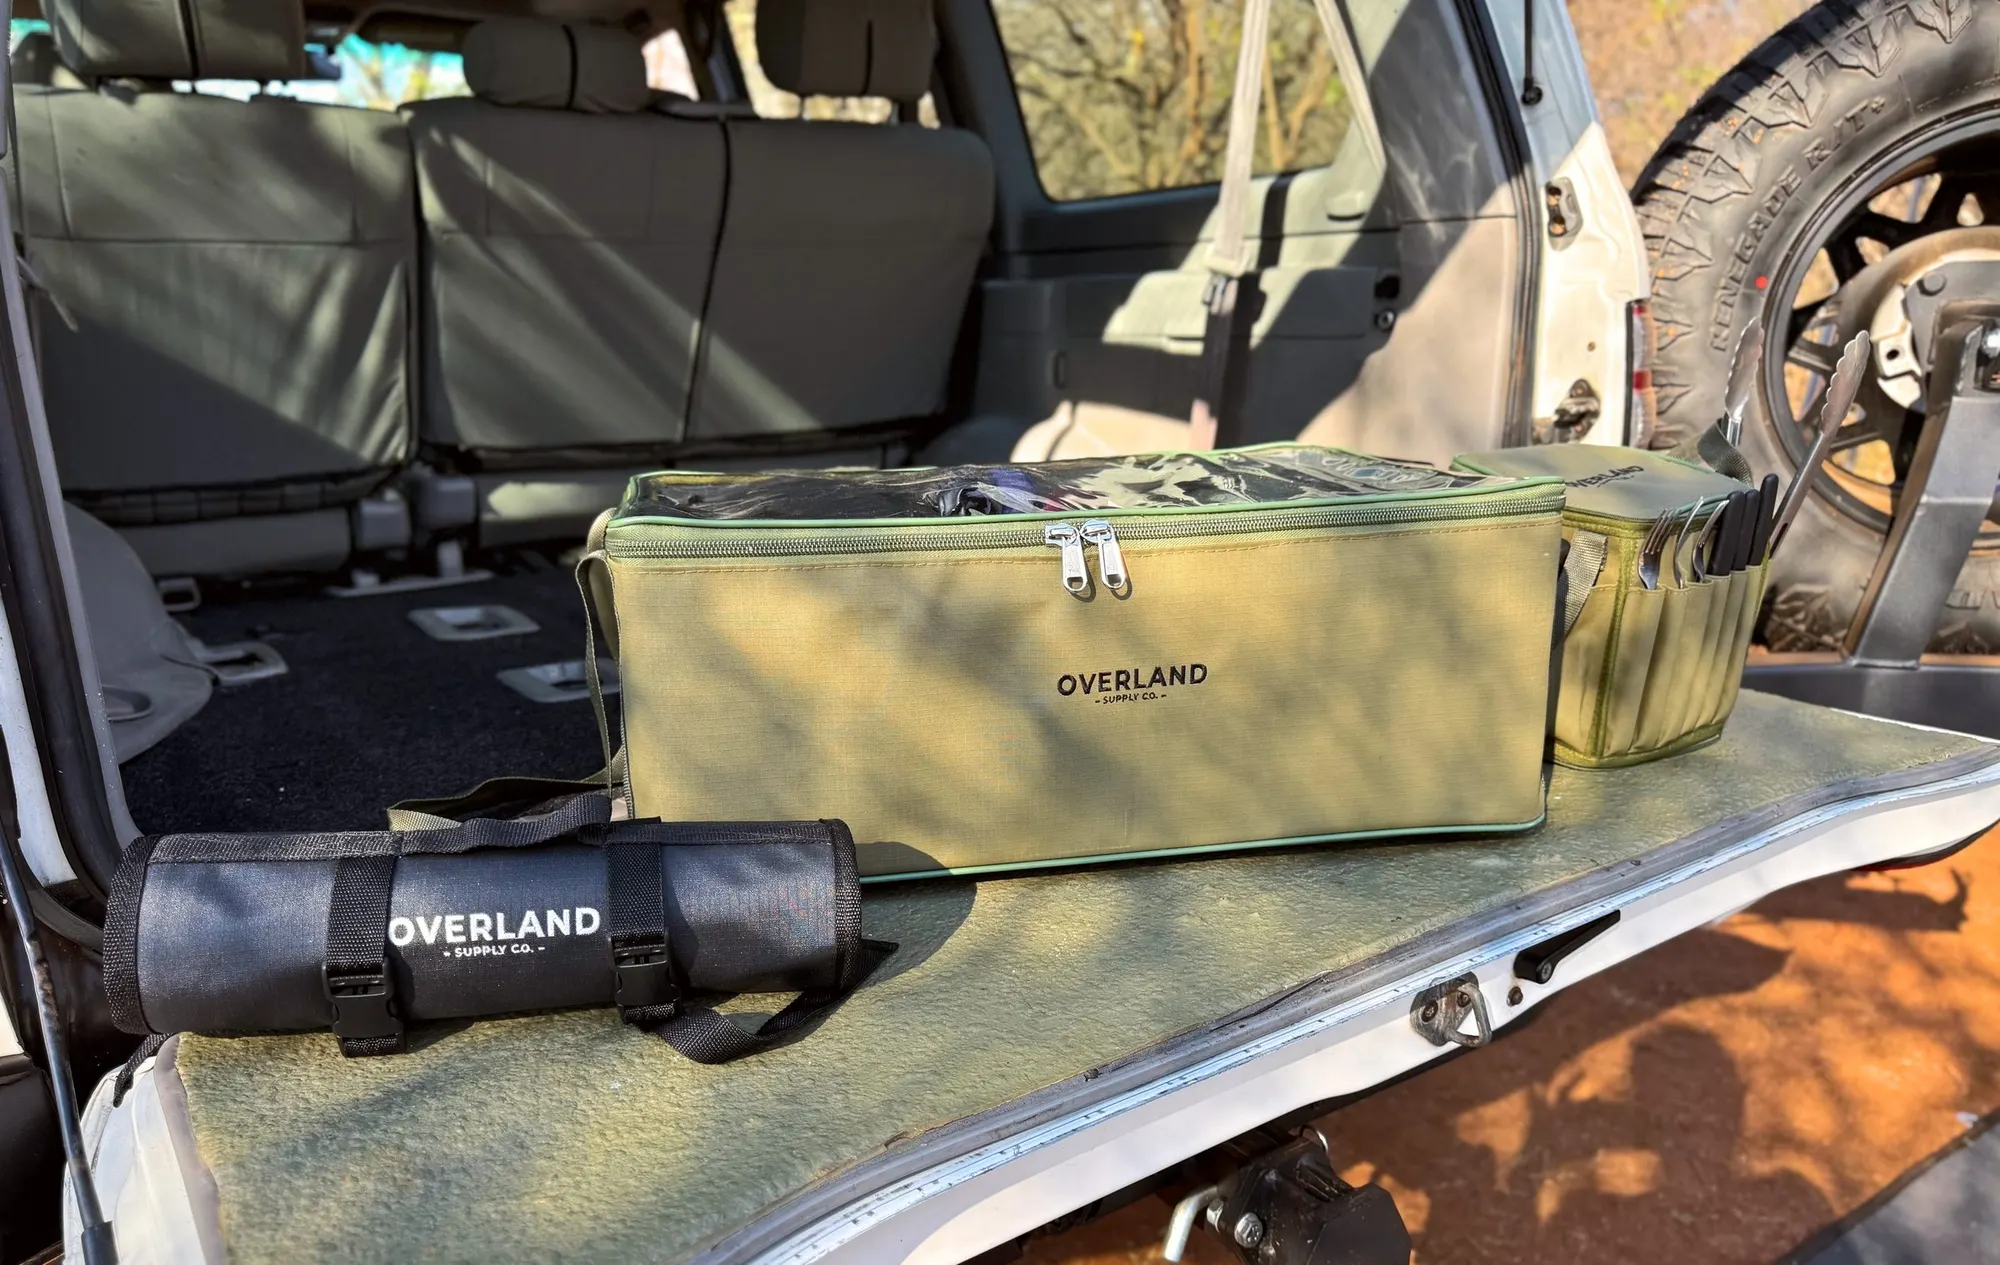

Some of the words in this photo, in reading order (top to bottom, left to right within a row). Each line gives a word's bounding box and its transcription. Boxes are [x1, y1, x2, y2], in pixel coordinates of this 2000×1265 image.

[1057, 664, 1208, 696] OVERLAND
[1103, 693, 1139, 705] SUPPLY
[1142, 692, 1158, 701] CO.
[388, 907, 600, 947] OVERLAND
[455, 944, 506, 958] SUPPLY
[511, 943, 534, 954] CO.
